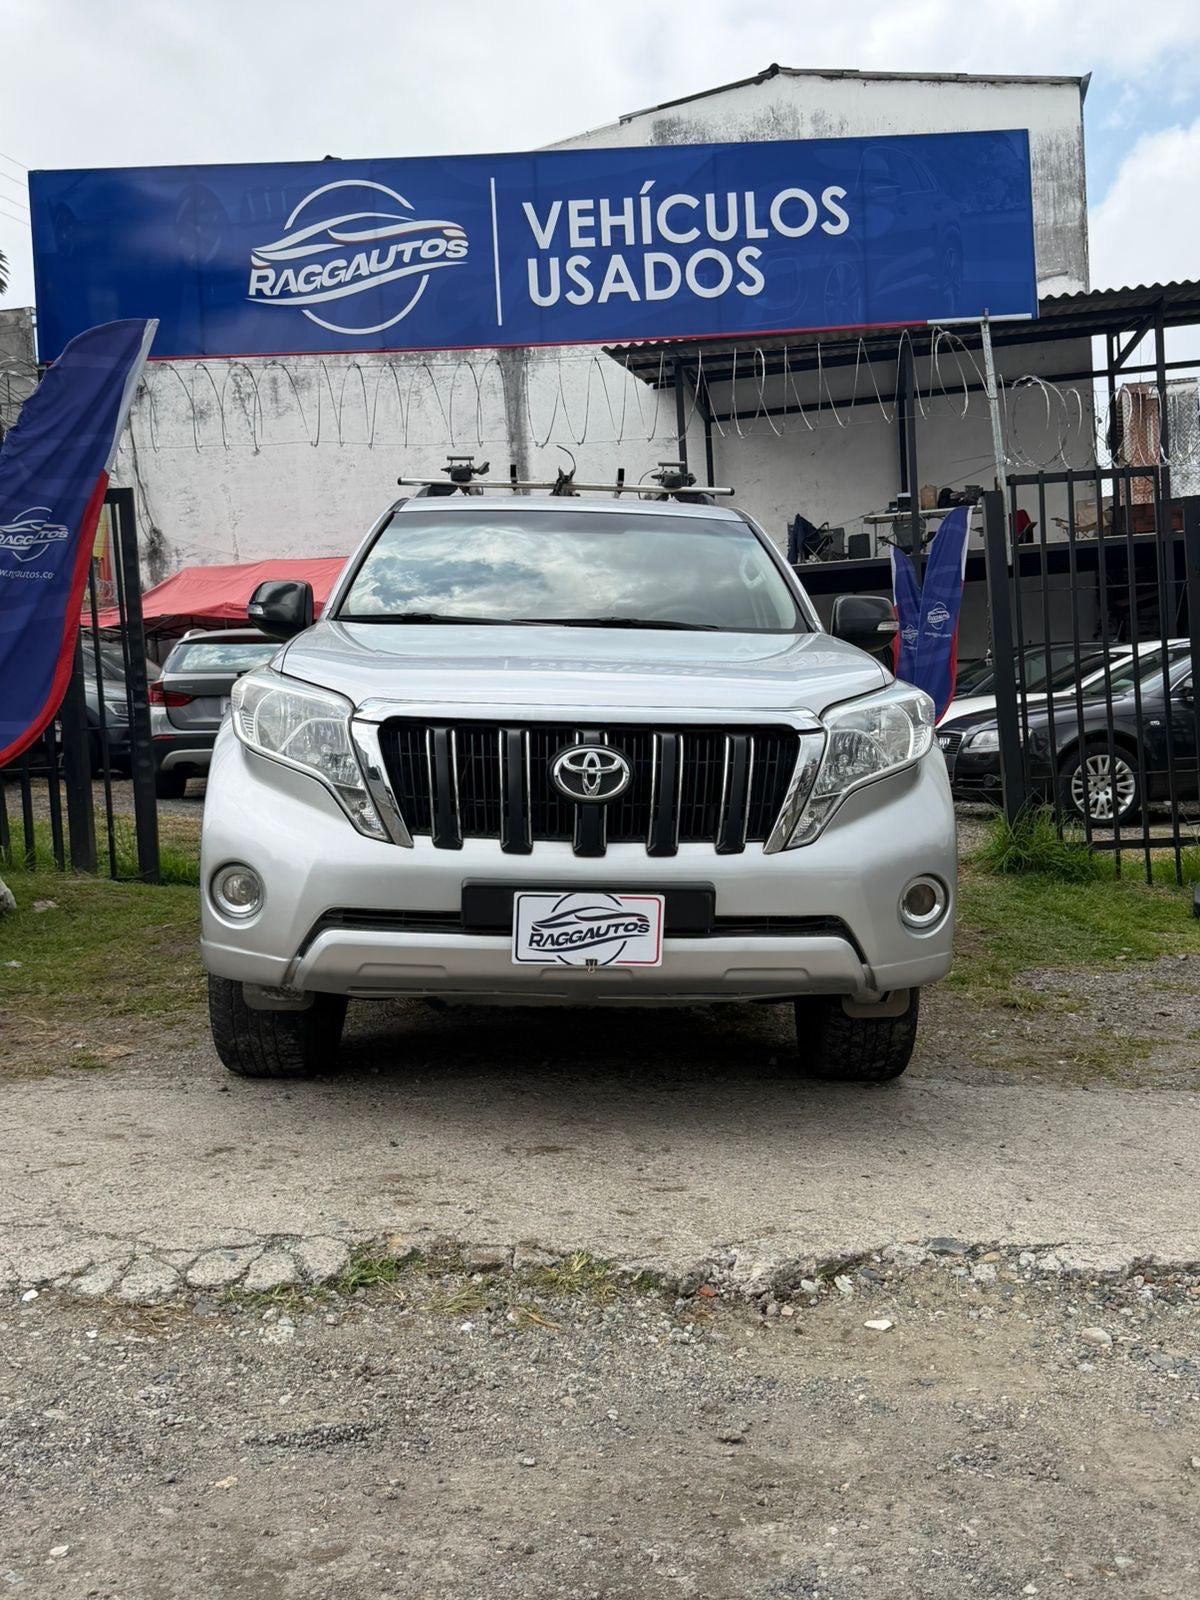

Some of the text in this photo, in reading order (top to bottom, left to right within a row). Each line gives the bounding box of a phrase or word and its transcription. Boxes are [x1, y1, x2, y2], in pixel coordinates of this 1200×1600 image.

[522, 180, 850, 250] VEHÍCULOS
[248, 238, 469, 296] RAGGAUTOS
[527, 246, 765, 307] USADOS
[528, 921, 650, 948] RAGGAUTOS
